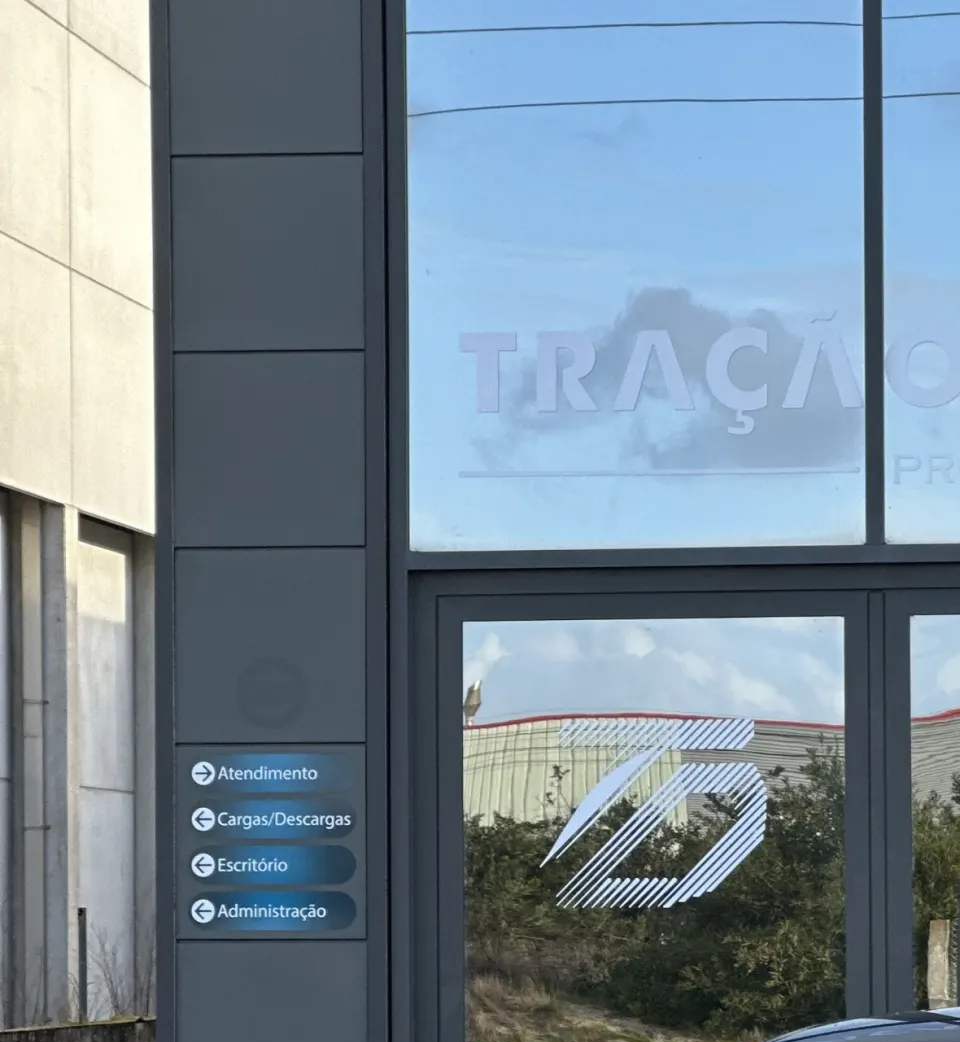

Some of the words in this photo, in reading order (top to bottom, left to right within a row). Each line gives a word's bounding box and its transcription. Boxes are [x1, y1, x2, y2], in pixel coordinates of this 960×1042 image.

[217, 765, 318, 781] Atendimento
[217, 811, 352, 830] Cargas/Descargas
[217, 857, 288, 873] Escritório
[217, 903, 327, 922] Administração
